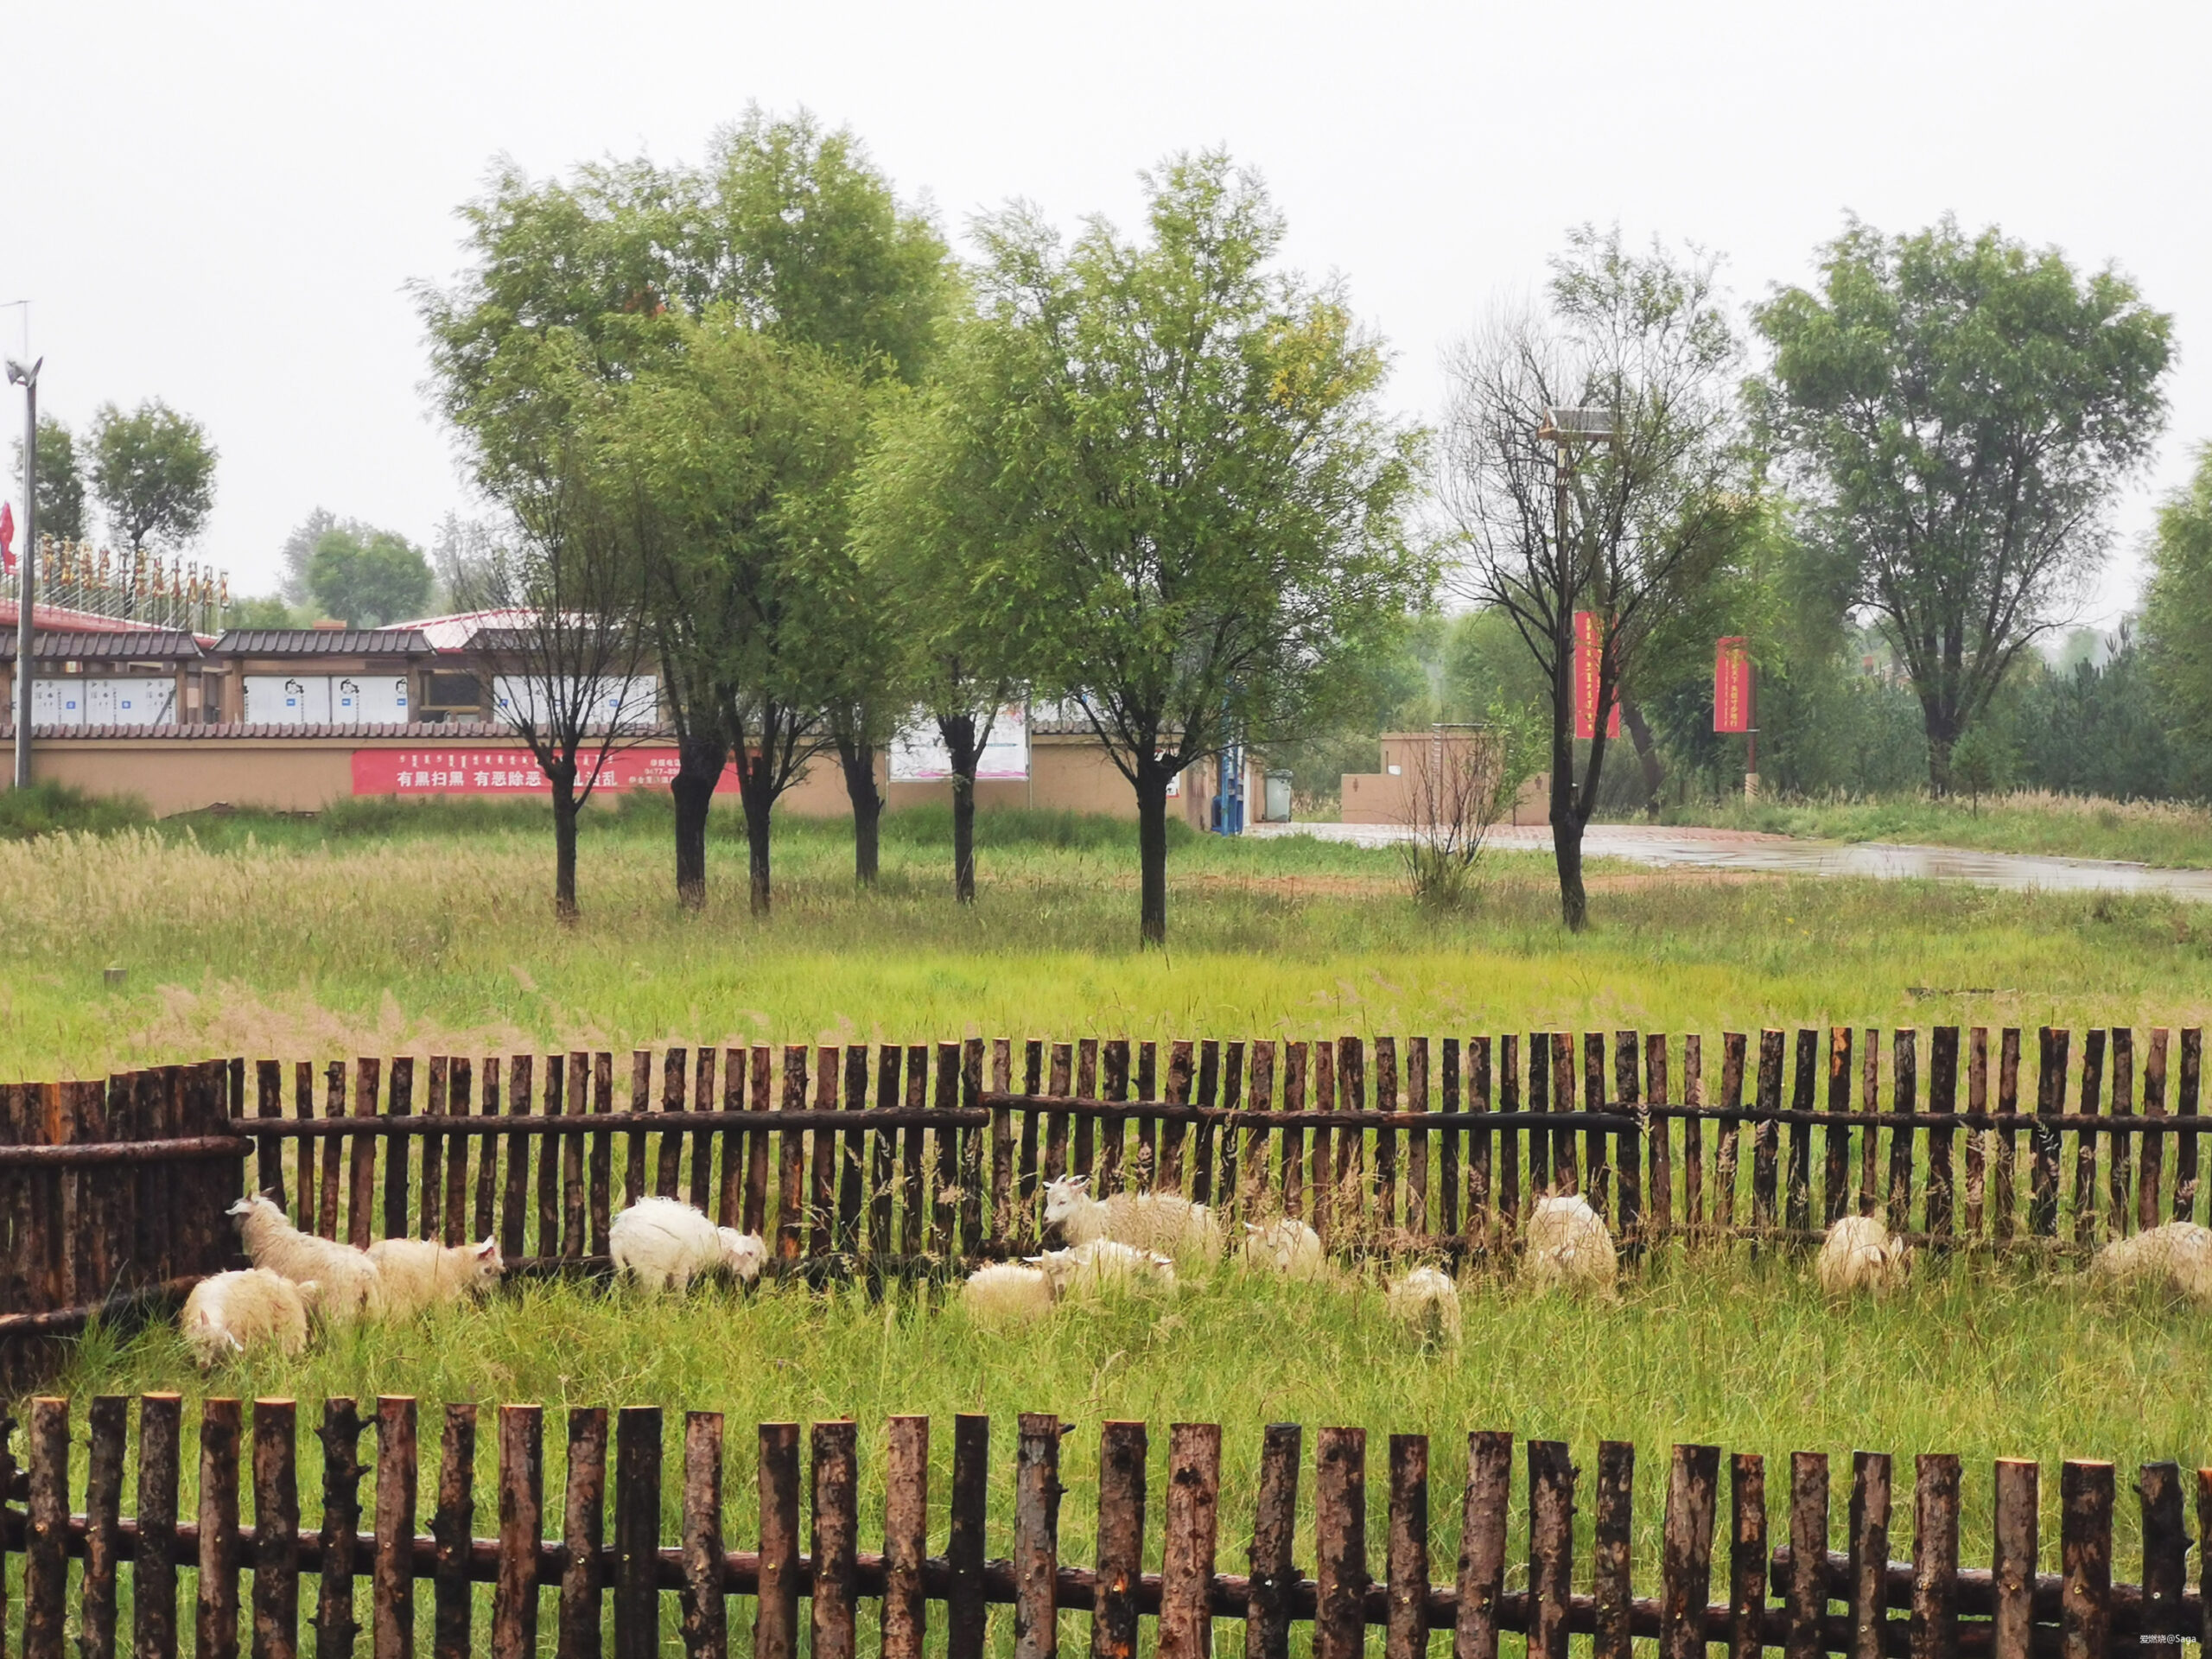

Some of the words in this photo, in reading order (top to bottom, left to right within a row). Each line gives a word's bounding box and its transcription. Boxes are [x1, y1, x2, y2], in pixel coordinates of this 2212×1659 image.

[397, 771, 464, 787] 有黑扫黑
[474, 771, 542, 787] 有恶除恶
[573, 771, 619, 787] 乱治乱
